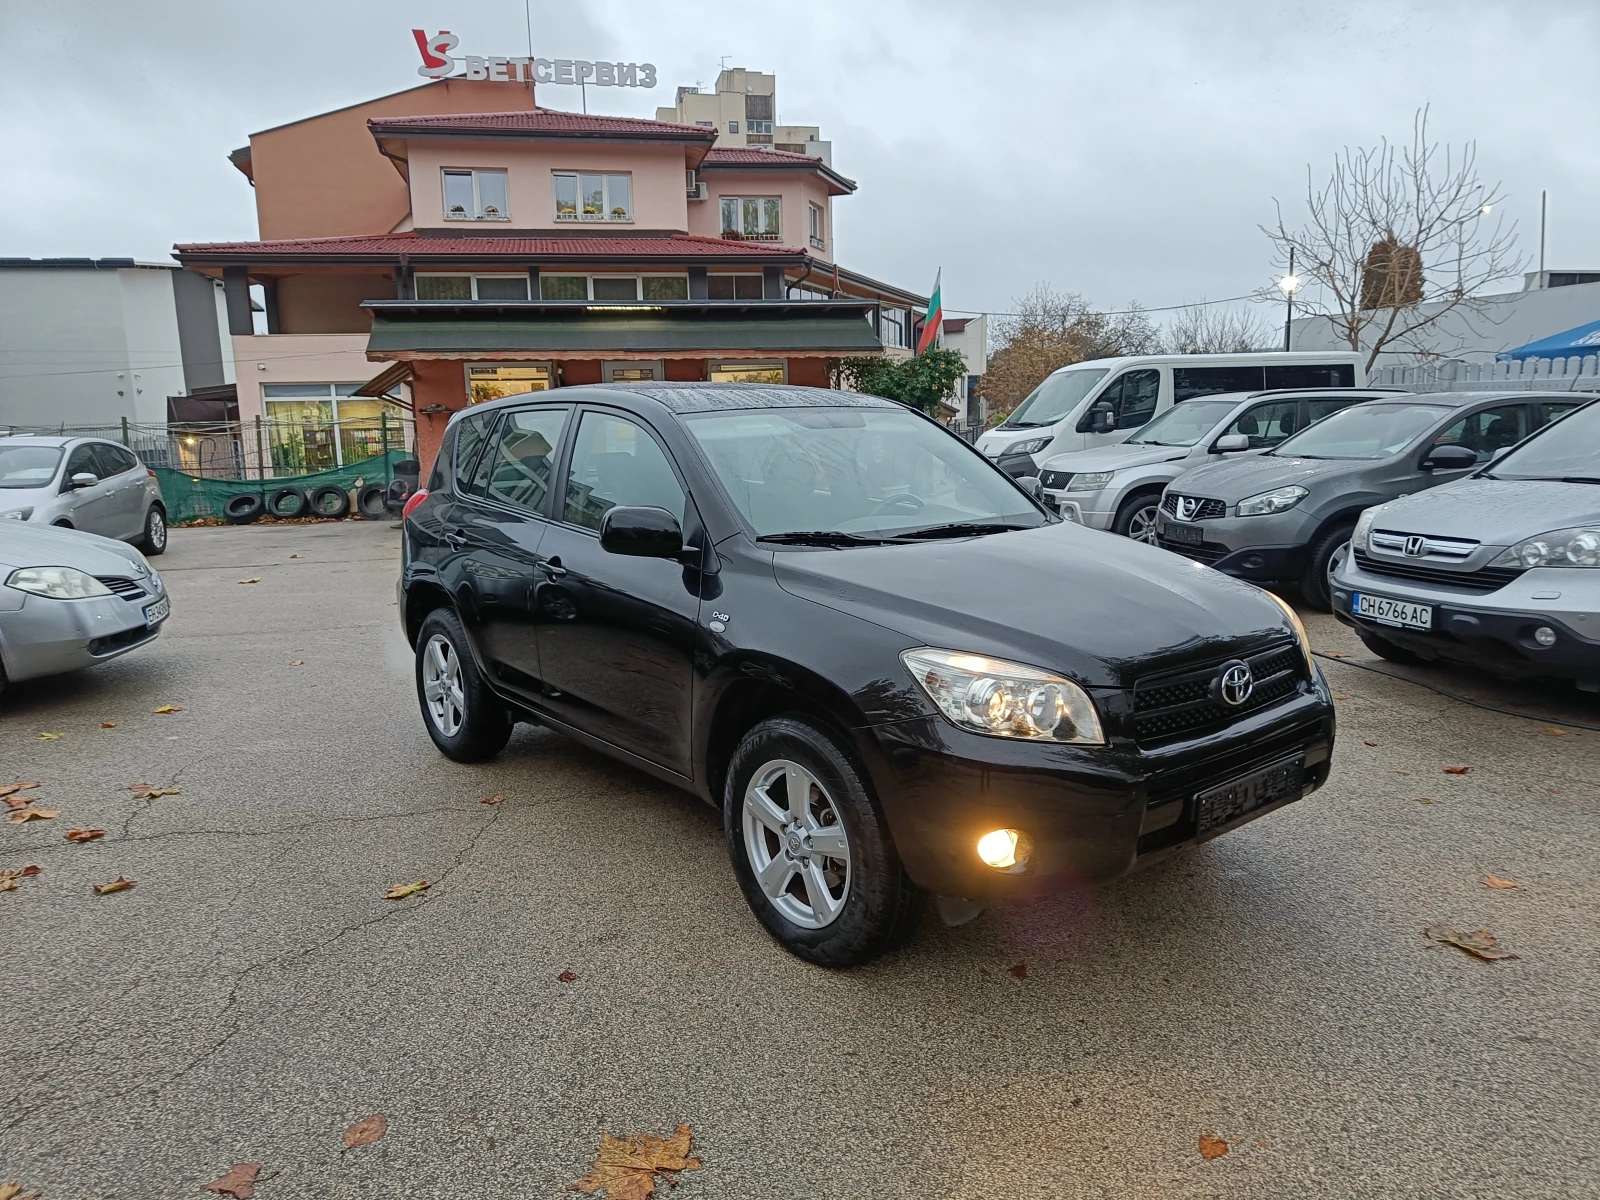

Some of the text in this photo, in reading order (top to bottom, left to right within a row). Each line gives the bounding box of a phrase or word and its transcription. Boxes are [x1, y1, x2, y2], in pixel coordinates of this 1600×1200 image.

[464, 55, 657, 88] ВЕТСЕРВИЗ
[1360, 597, 1376, 614] CH
[1377, 600, 1408, 620] 6766
[1410, 607, 1429, 624] AC
